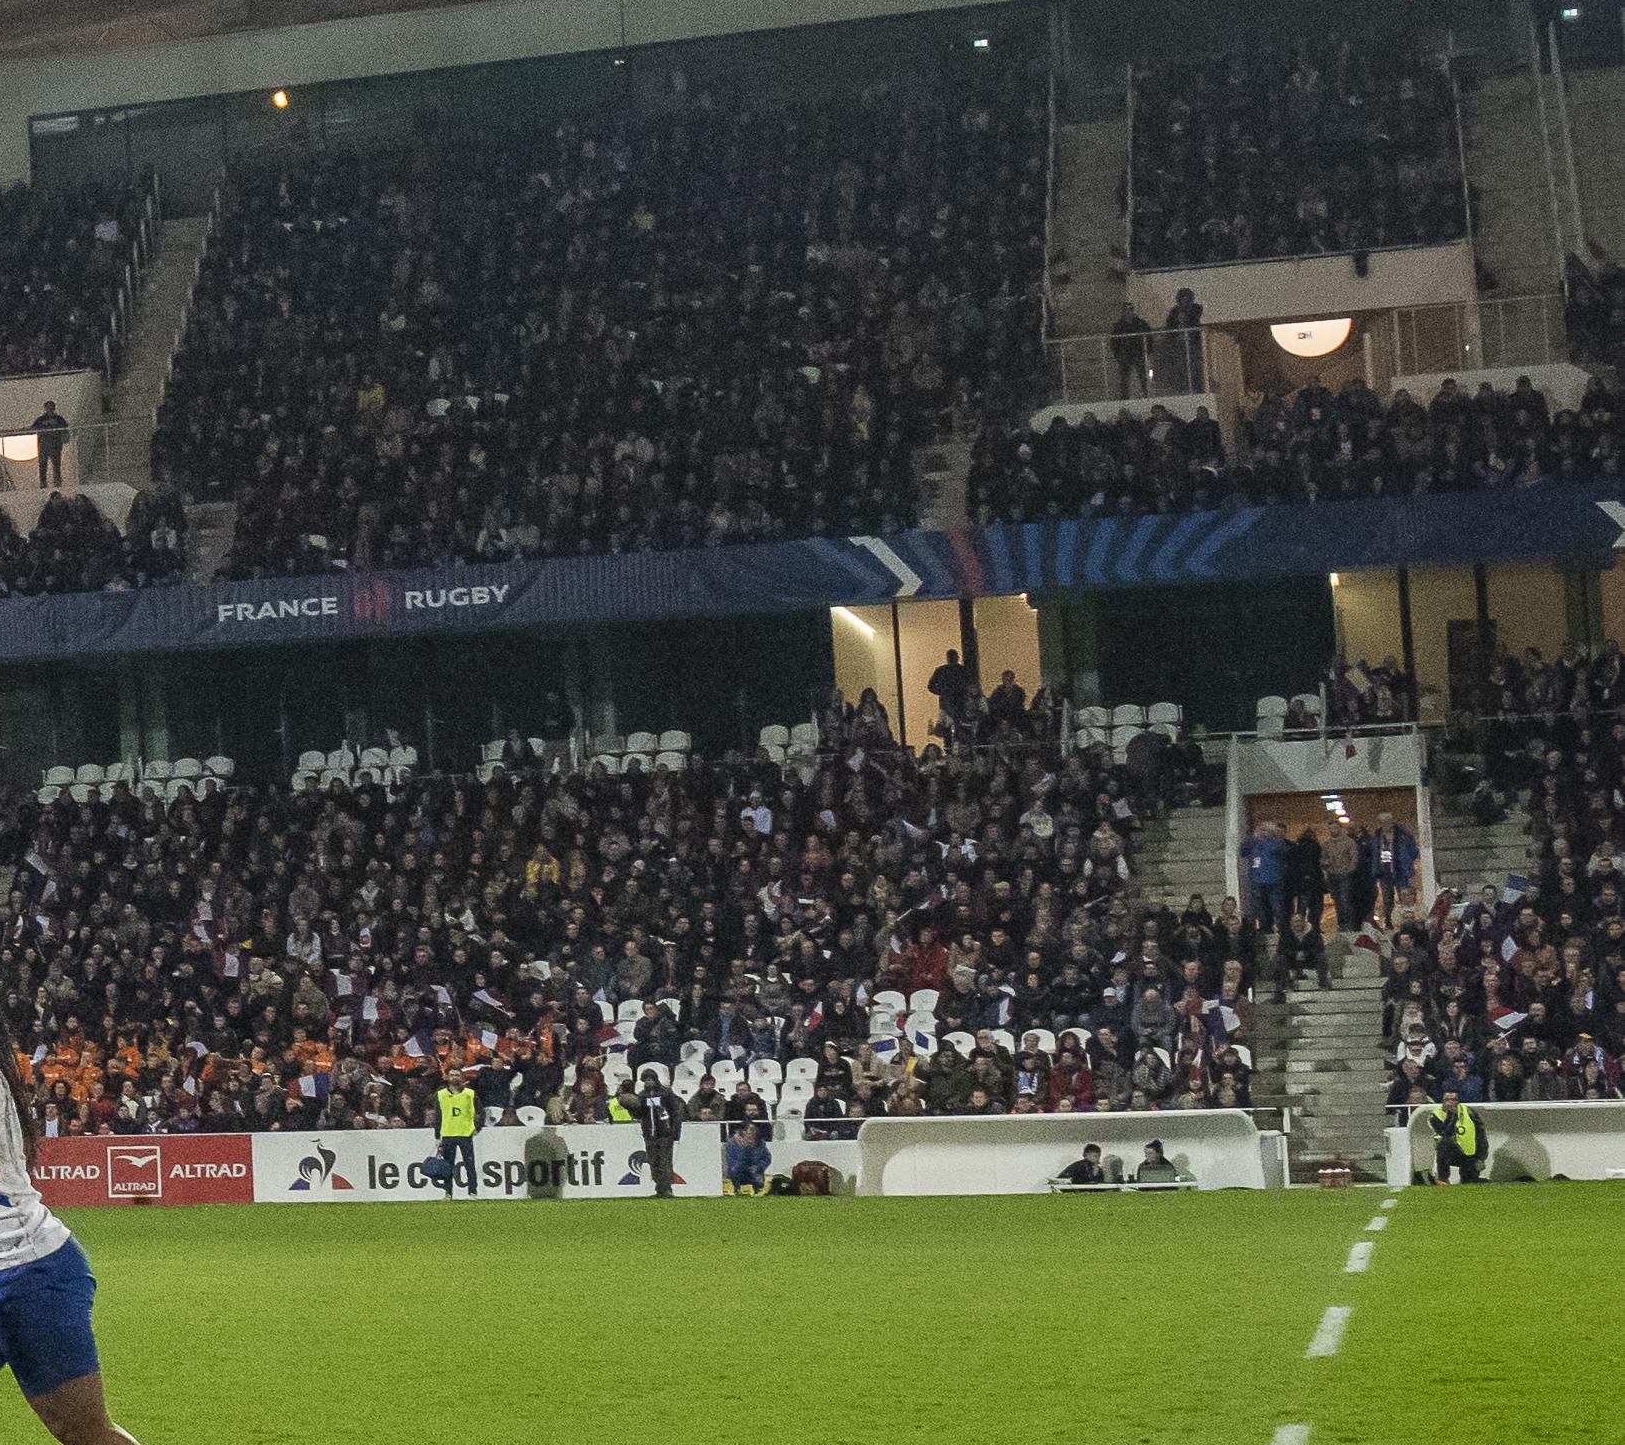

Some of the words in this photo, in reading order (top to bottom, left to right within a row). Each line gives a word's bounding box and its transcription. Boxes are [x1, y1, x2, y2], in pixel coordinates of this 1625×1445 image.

[218, 597, 338, 622] FRANCE
[405, 585, 509, 609] RUGBY
[169, 1163, 247, 1179] ALTRAD
[368, 1155, 400, 1189] le
[483, 1151, 604, 1195] sportif
[113, 1182, 157, 1192] ALTRAD
